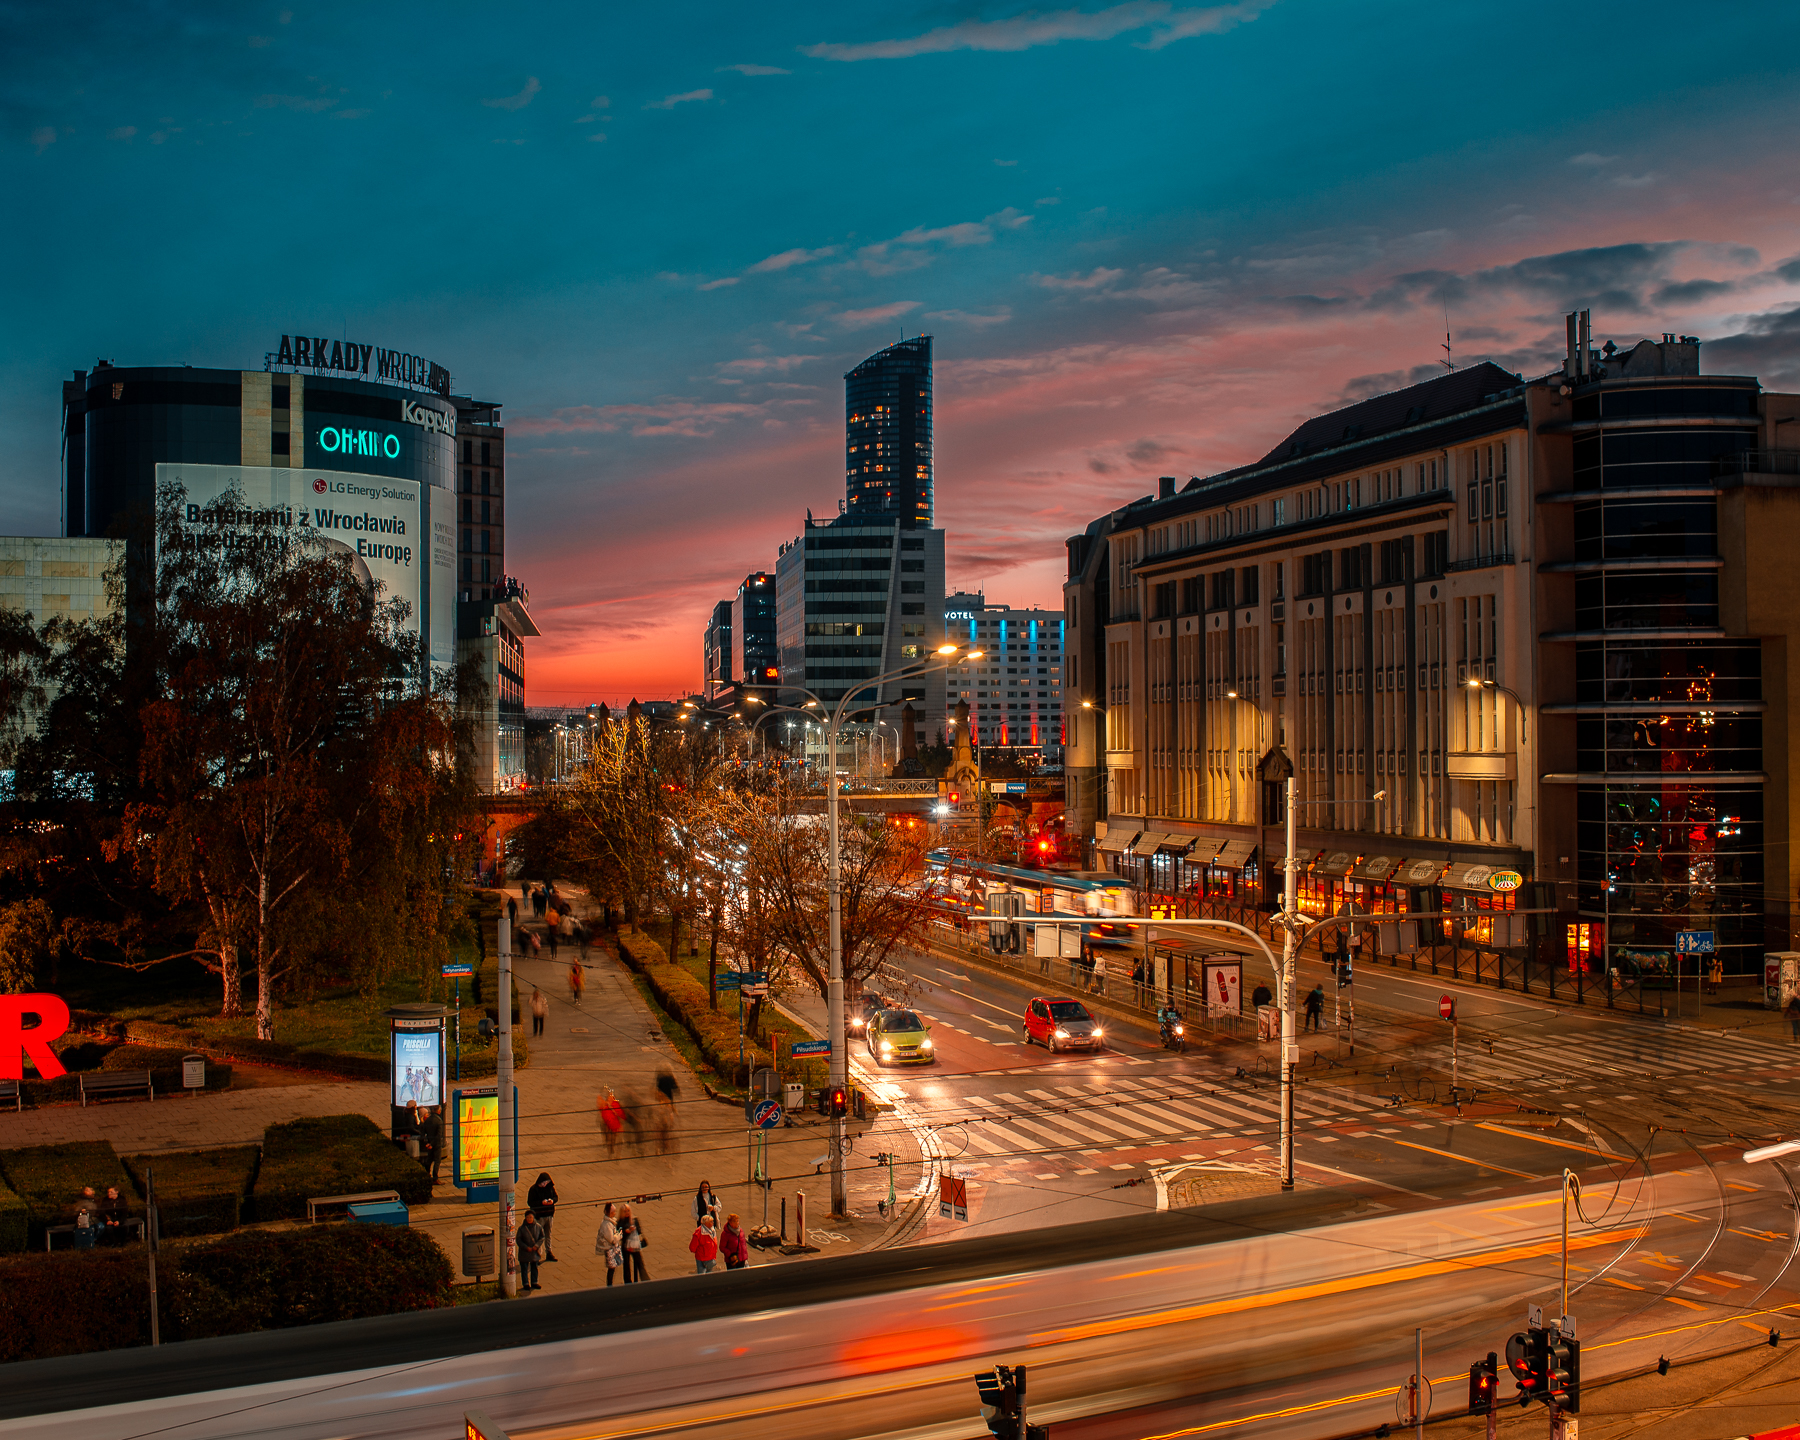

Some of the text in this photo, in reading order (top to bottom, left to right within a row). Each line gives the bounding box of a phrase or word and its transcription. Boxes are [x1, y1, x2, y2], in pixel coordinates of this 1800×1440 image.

[277, 334, 374, 374] ARKADY
[329, 482, 416, 502] LG Energy Solution
[299, 510, 310, 528] z
[315, 508, 406, 536] Wrocławia
[356, 537, 412, 567] Europę
[944, 611, 975, 620] VOTEL
[0, 992, 70, 1080] R
[402, 1038, 431, 1049] PRISCILLA
